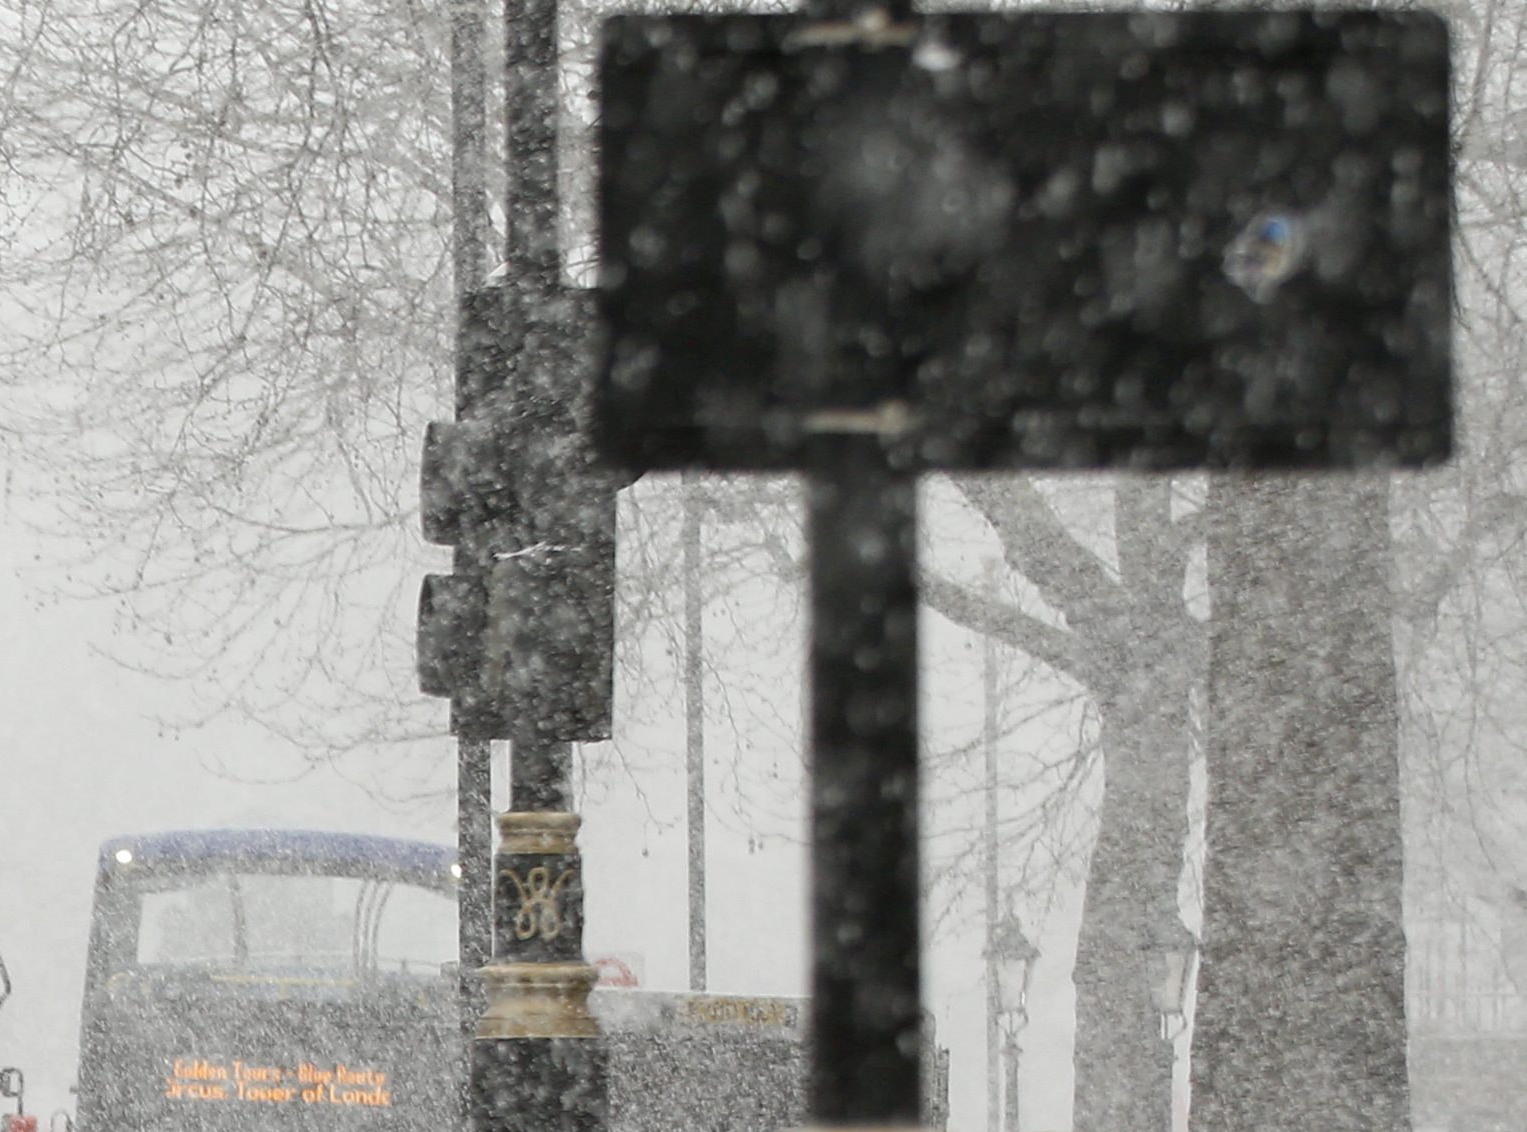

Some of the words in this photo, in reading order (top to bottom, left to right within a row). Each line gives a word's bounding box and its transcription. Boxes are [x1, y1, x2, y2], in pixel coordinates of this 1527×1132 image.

[174, 1058, 227, 1080] Golden
[232, 1060, 283, 1083] Tours
[301, 1083, 324, 1104] of
